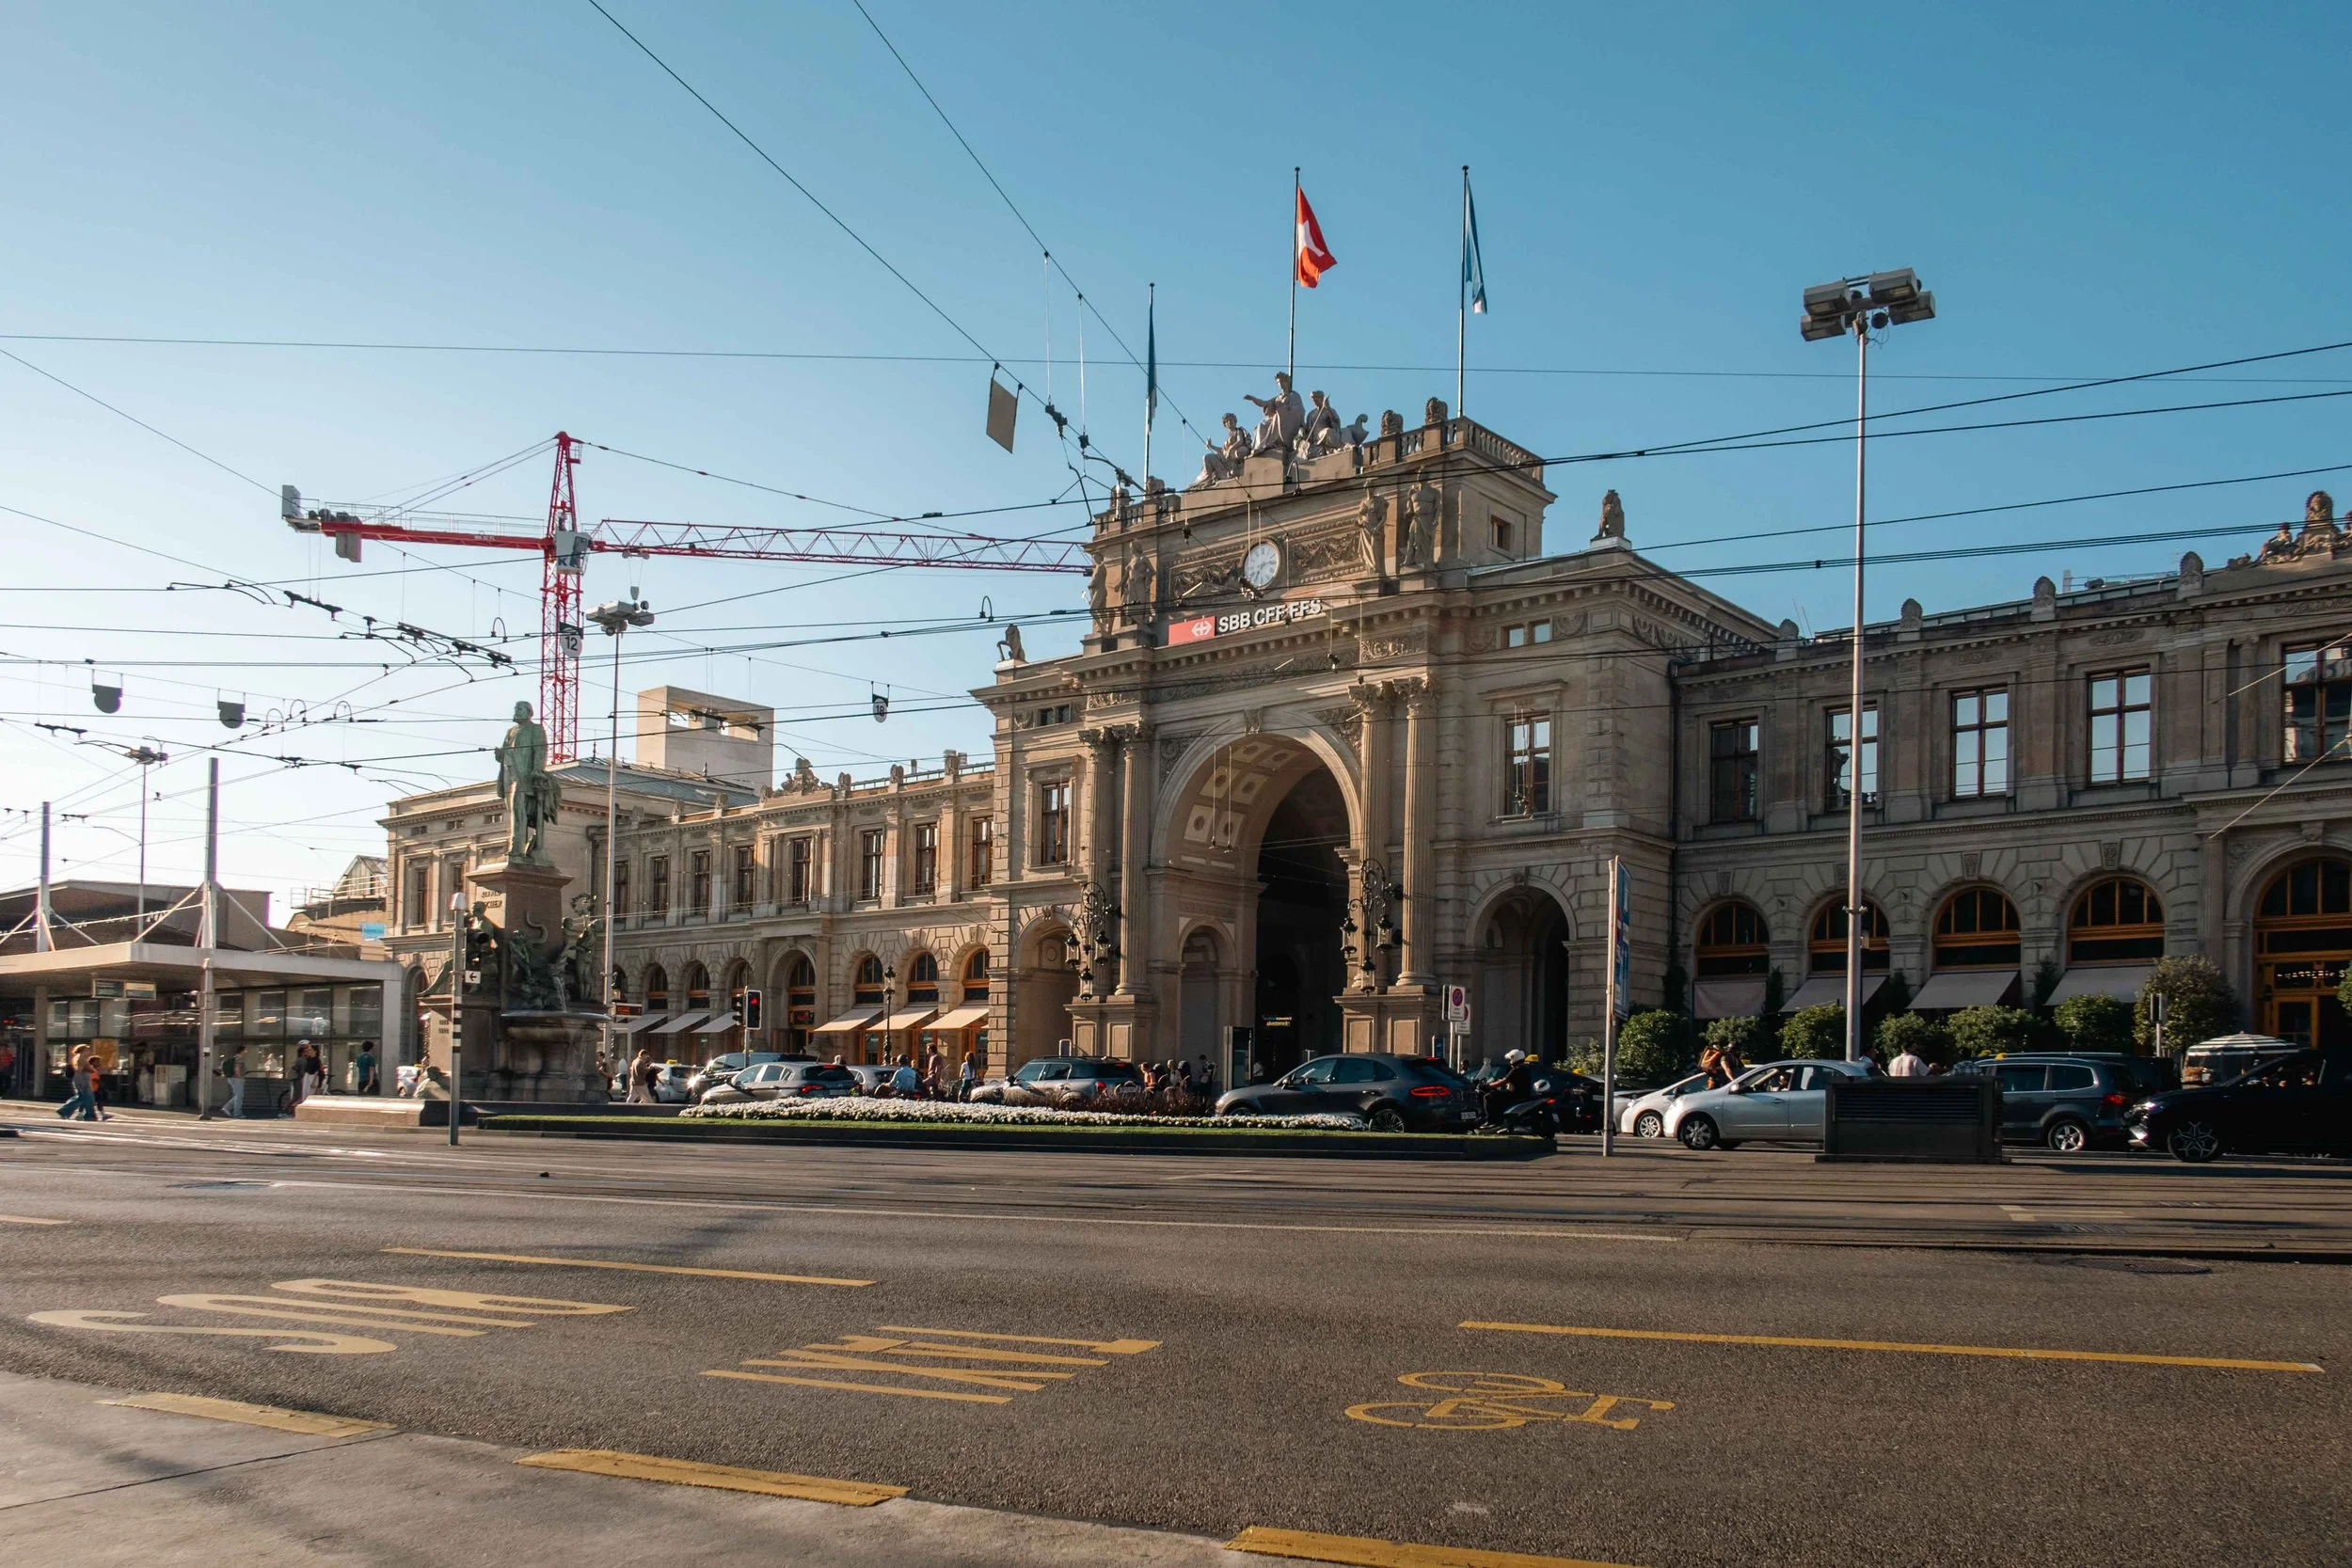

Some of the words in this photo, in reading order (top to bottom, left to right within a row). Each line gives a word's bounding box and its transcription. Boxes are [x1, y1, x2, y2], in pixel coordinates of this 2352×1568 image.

[564, 635, 578, 651] 12
[1218, 611, 1250, 633] SBB
[1254, 604, 1286, 626] CFF
[1289, 598, 1322, 619] FFS
[27, 1278, 634, 1354] BUS
[699, 1325, 1163, 1403] TAXI
